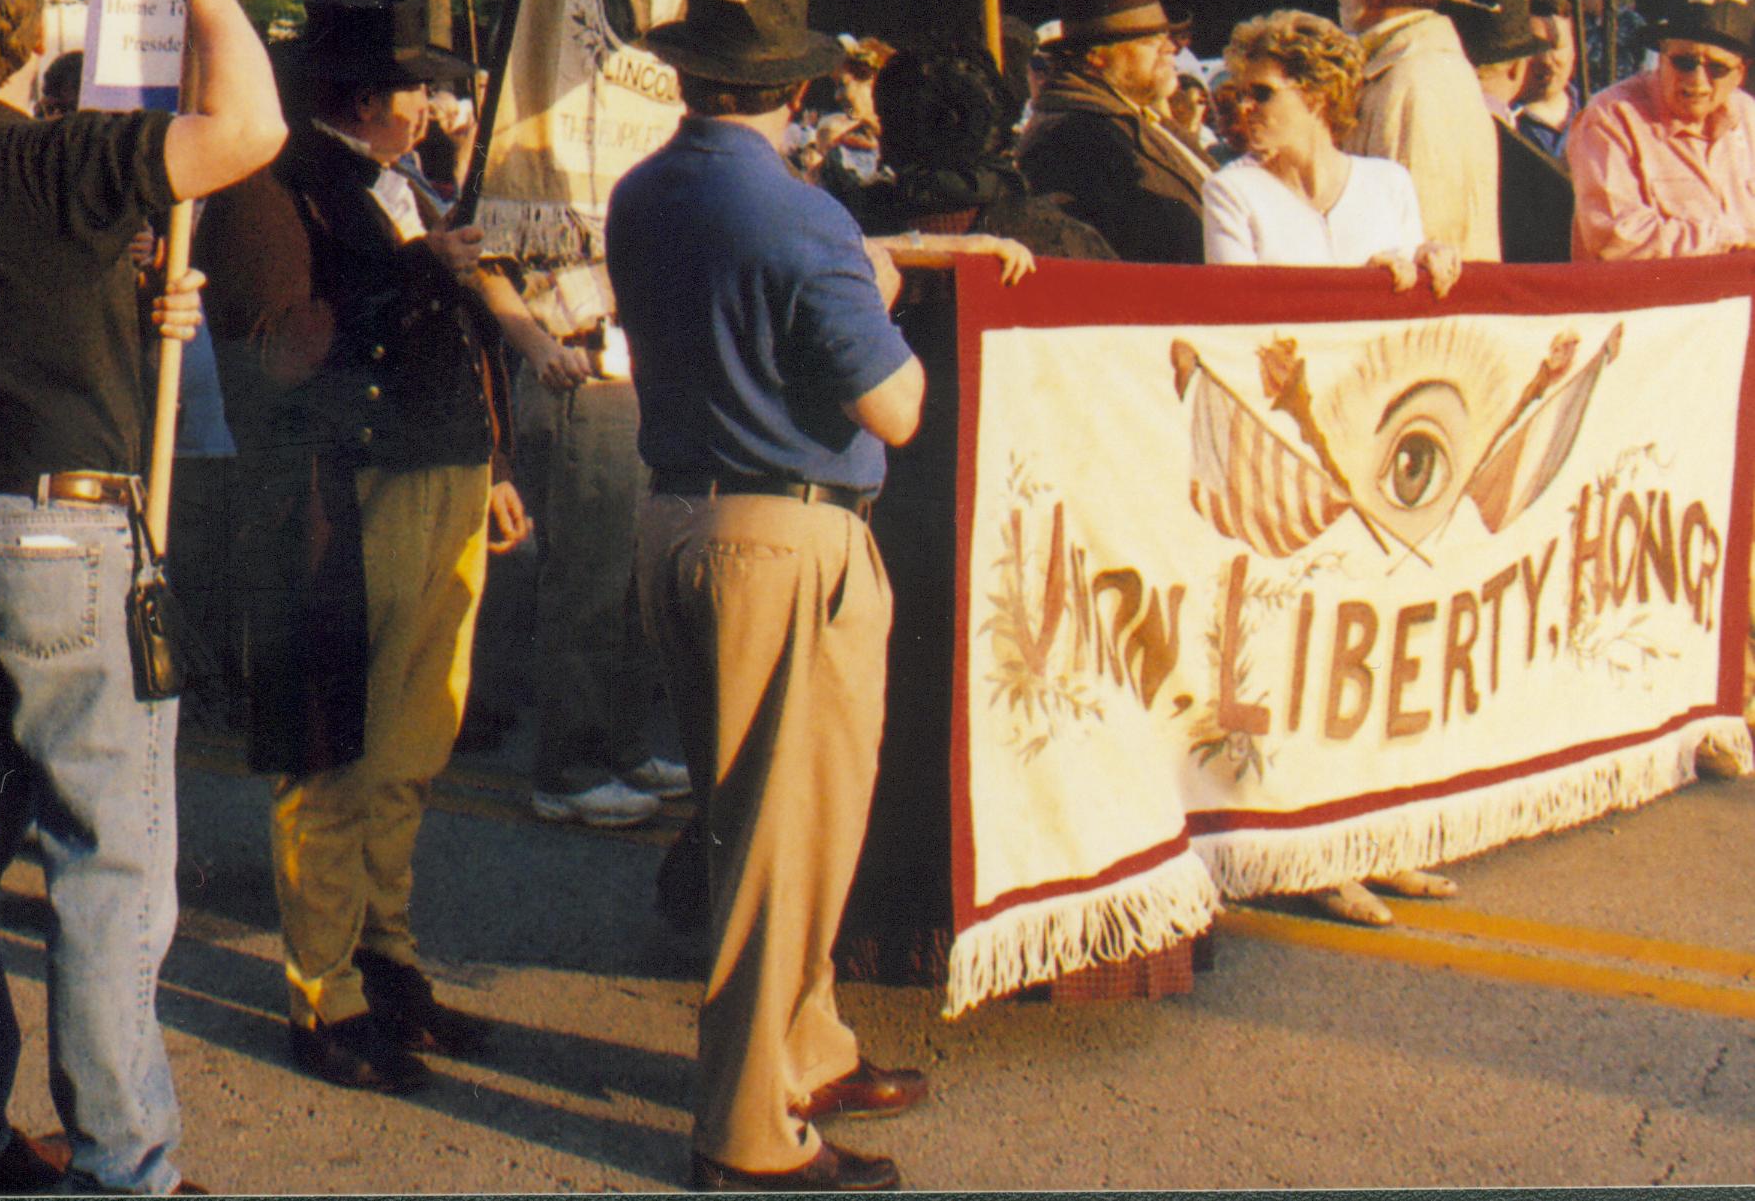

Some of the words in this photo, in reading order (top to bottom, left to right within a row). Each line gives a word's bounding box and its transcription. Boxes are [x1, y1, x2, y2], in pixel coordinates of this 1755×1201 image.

[122, 34, 182, 52] Preside
[604, 54, 678, 101] LINCOL
[1219, 537, 1559, 741] LIBERTY,
